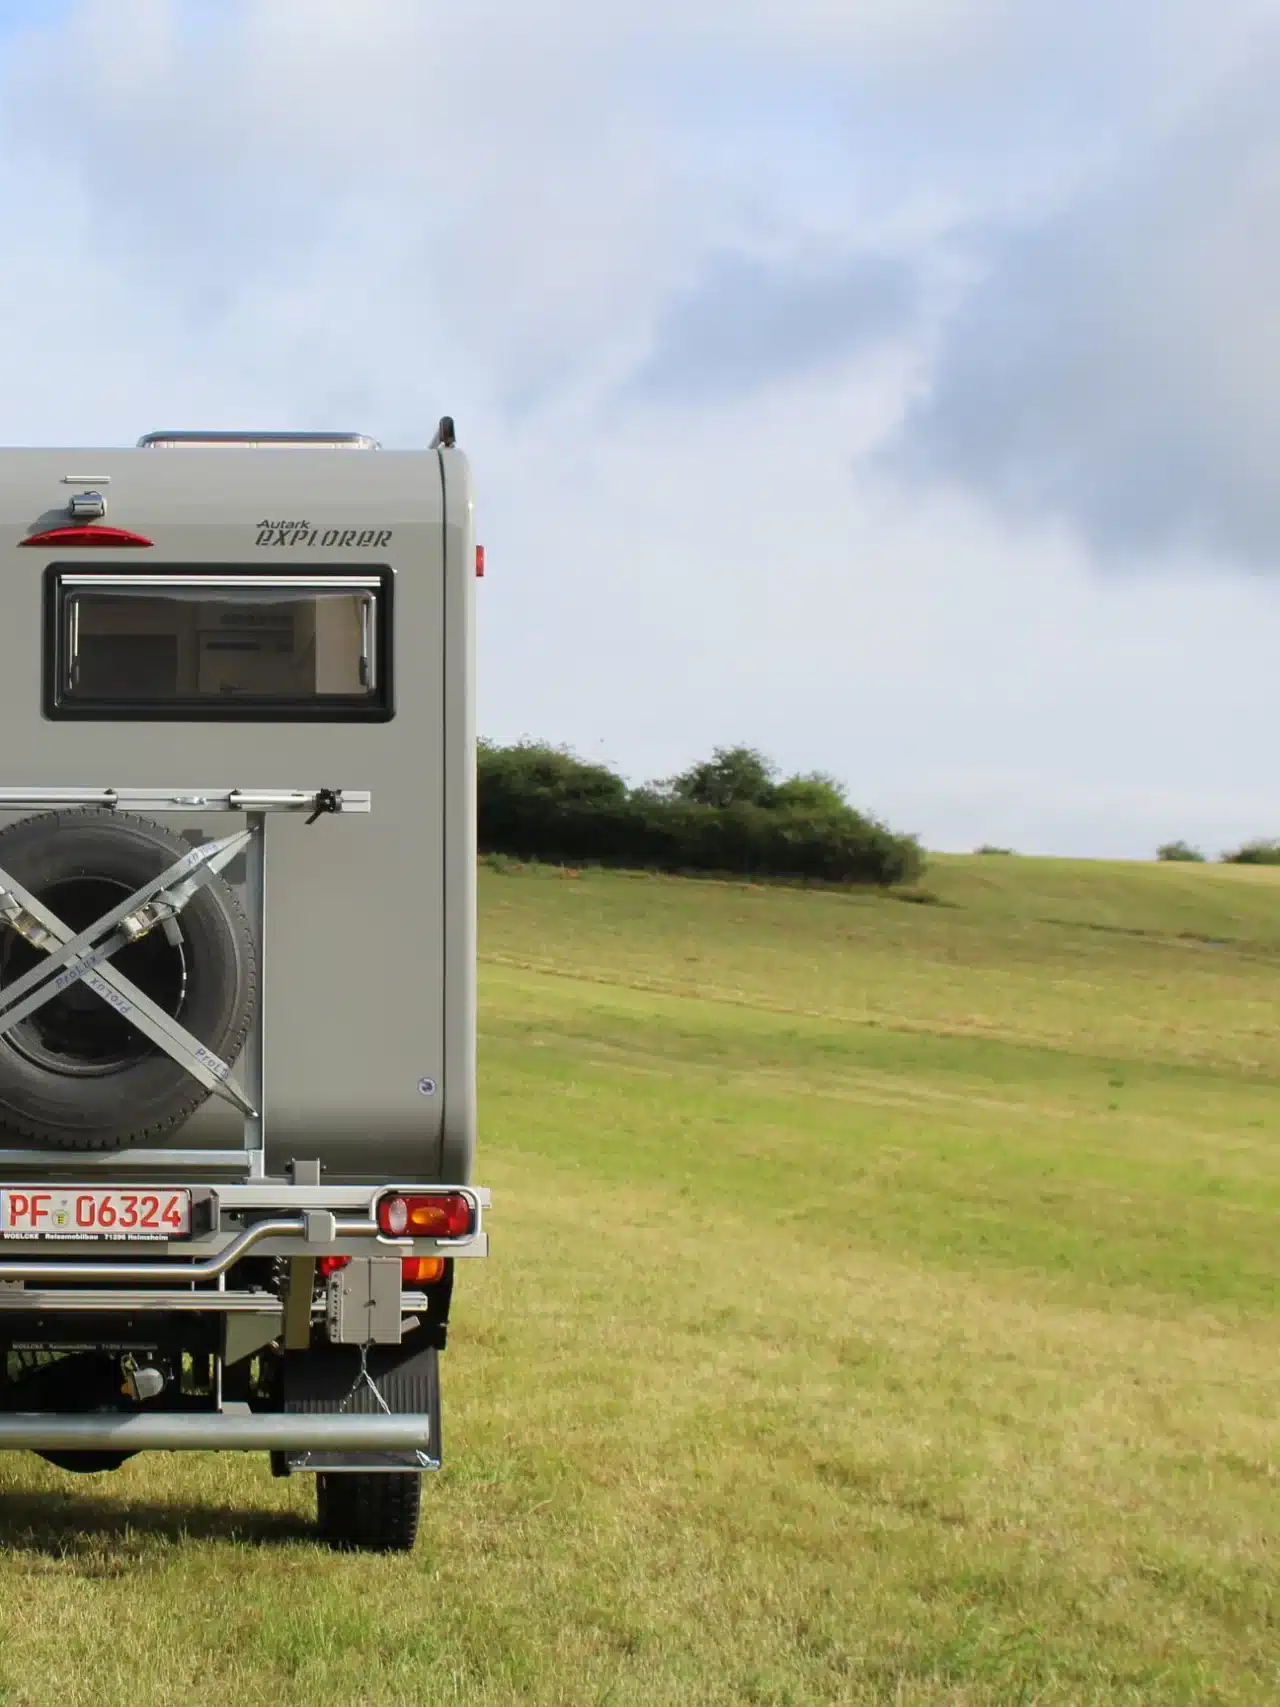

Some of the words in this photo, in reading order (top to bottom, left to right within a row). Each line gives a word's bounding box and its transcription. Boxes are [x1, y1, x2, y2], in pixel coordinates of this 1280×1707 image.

[256, 519, 311, 529] Autark
[9, 1194, 52, 1226] PF
[75, 1195, 181, 1228] 06324
